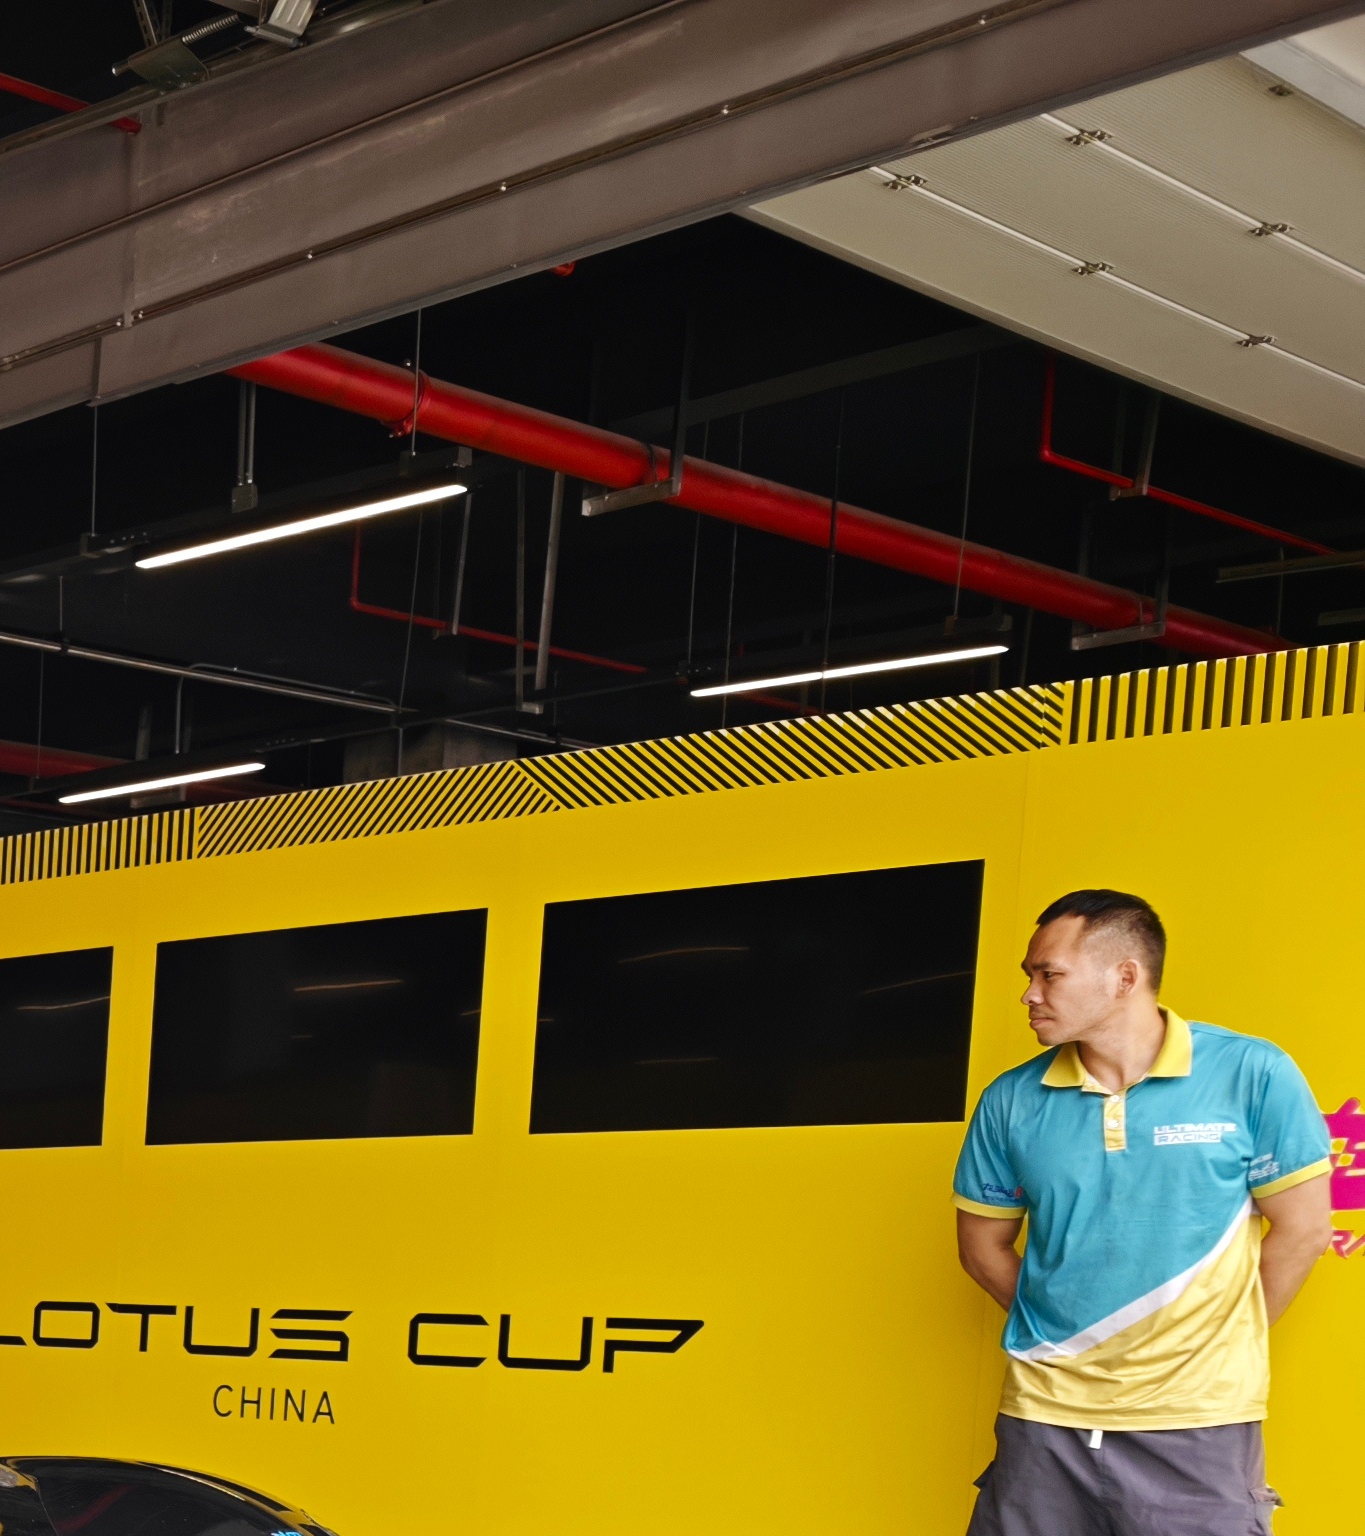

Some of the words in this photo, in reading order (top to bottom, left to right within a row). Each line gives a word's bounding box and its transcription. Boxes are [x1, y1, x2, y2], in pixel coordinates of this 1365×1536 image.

[1153, 1122, 1237, 1133] ULTIMATE
[1155, 1133, 1221, 1144] RACING
[408, 1312, 706, 1374] CUP
[212, 1383, 337, 1426] CHINA
